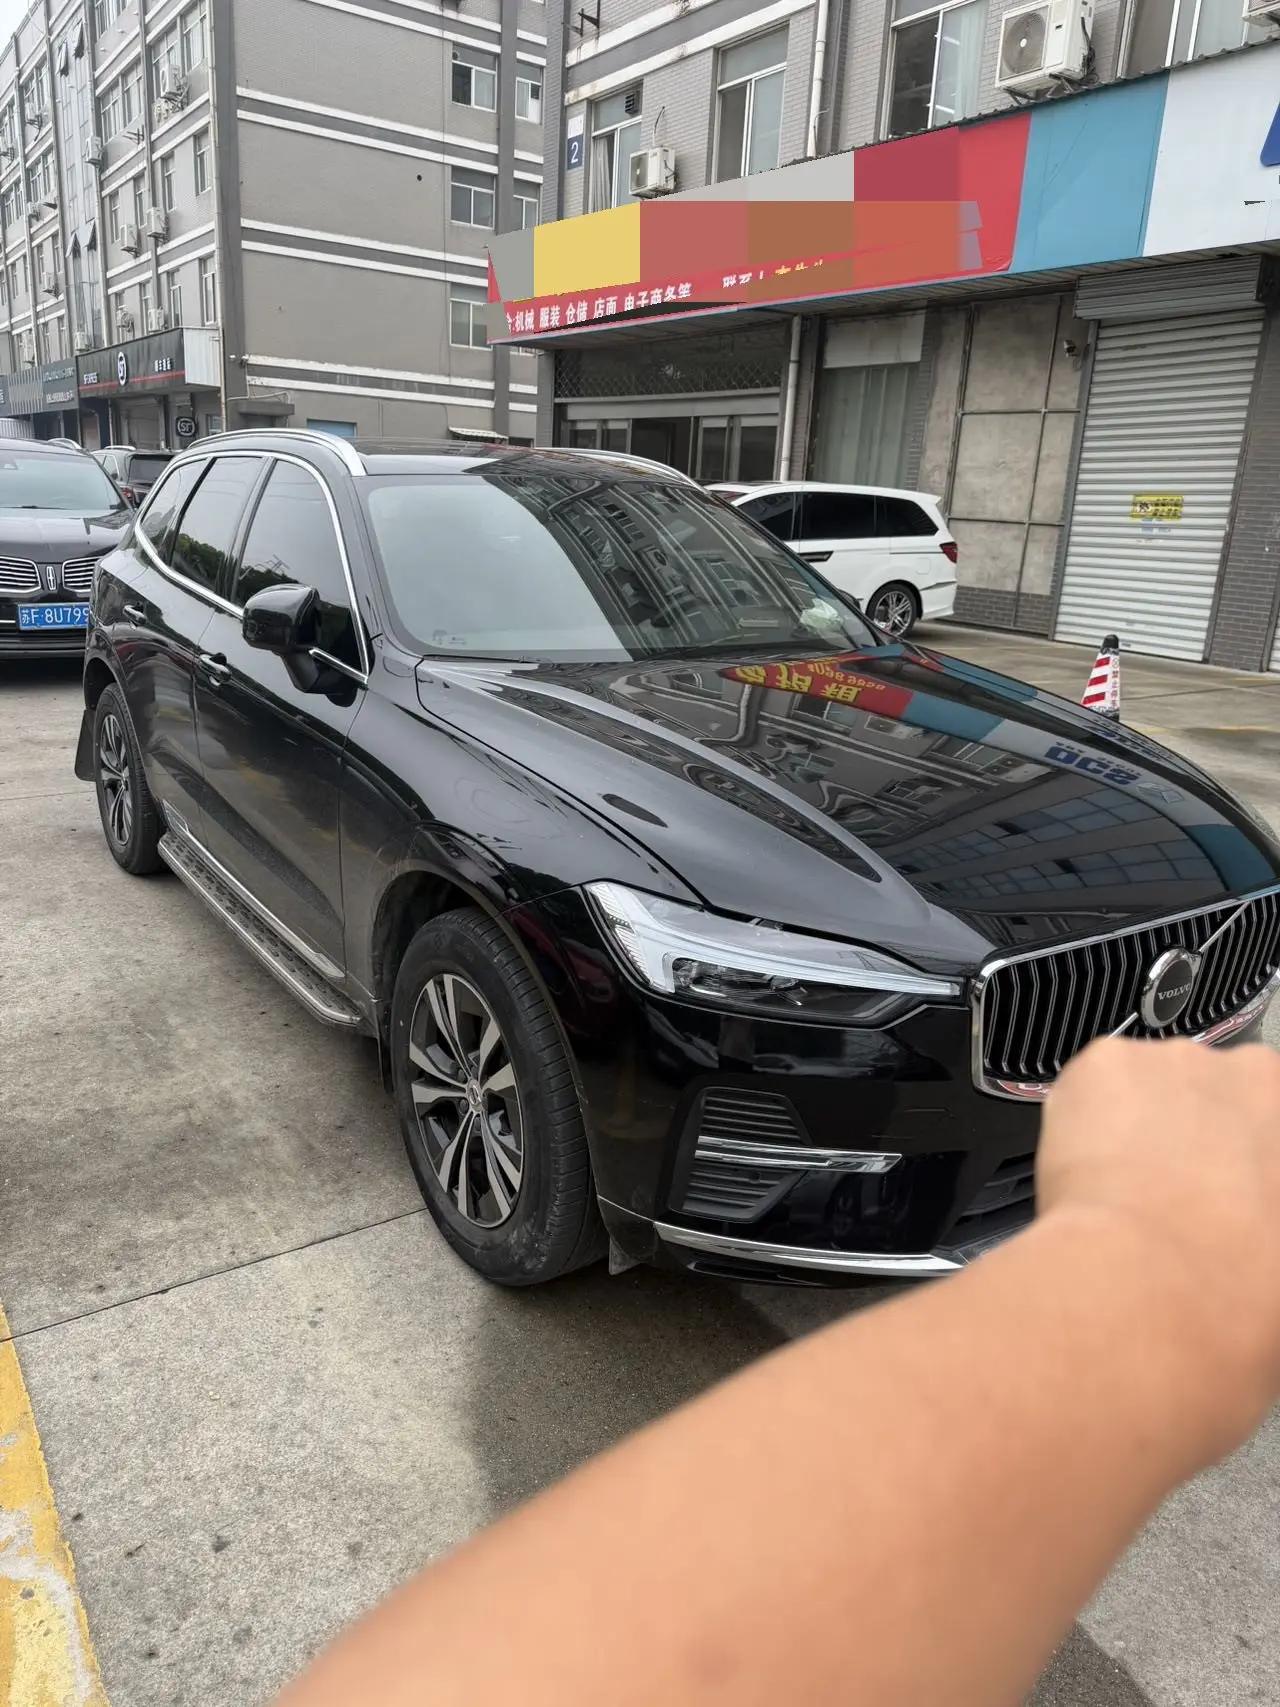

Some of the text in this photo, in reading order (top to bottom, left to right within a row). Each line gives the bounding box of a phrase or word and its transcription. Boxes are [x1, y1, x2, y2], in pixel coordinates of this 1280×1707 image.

[571, 141, 579, 164] 2
[540, 304, 560, 328] 服装
[566, 300, 588, 324] 仓储
[593, 296, 618, 319] 店面
[1158, 983, 1192, 1000] VOLVO
